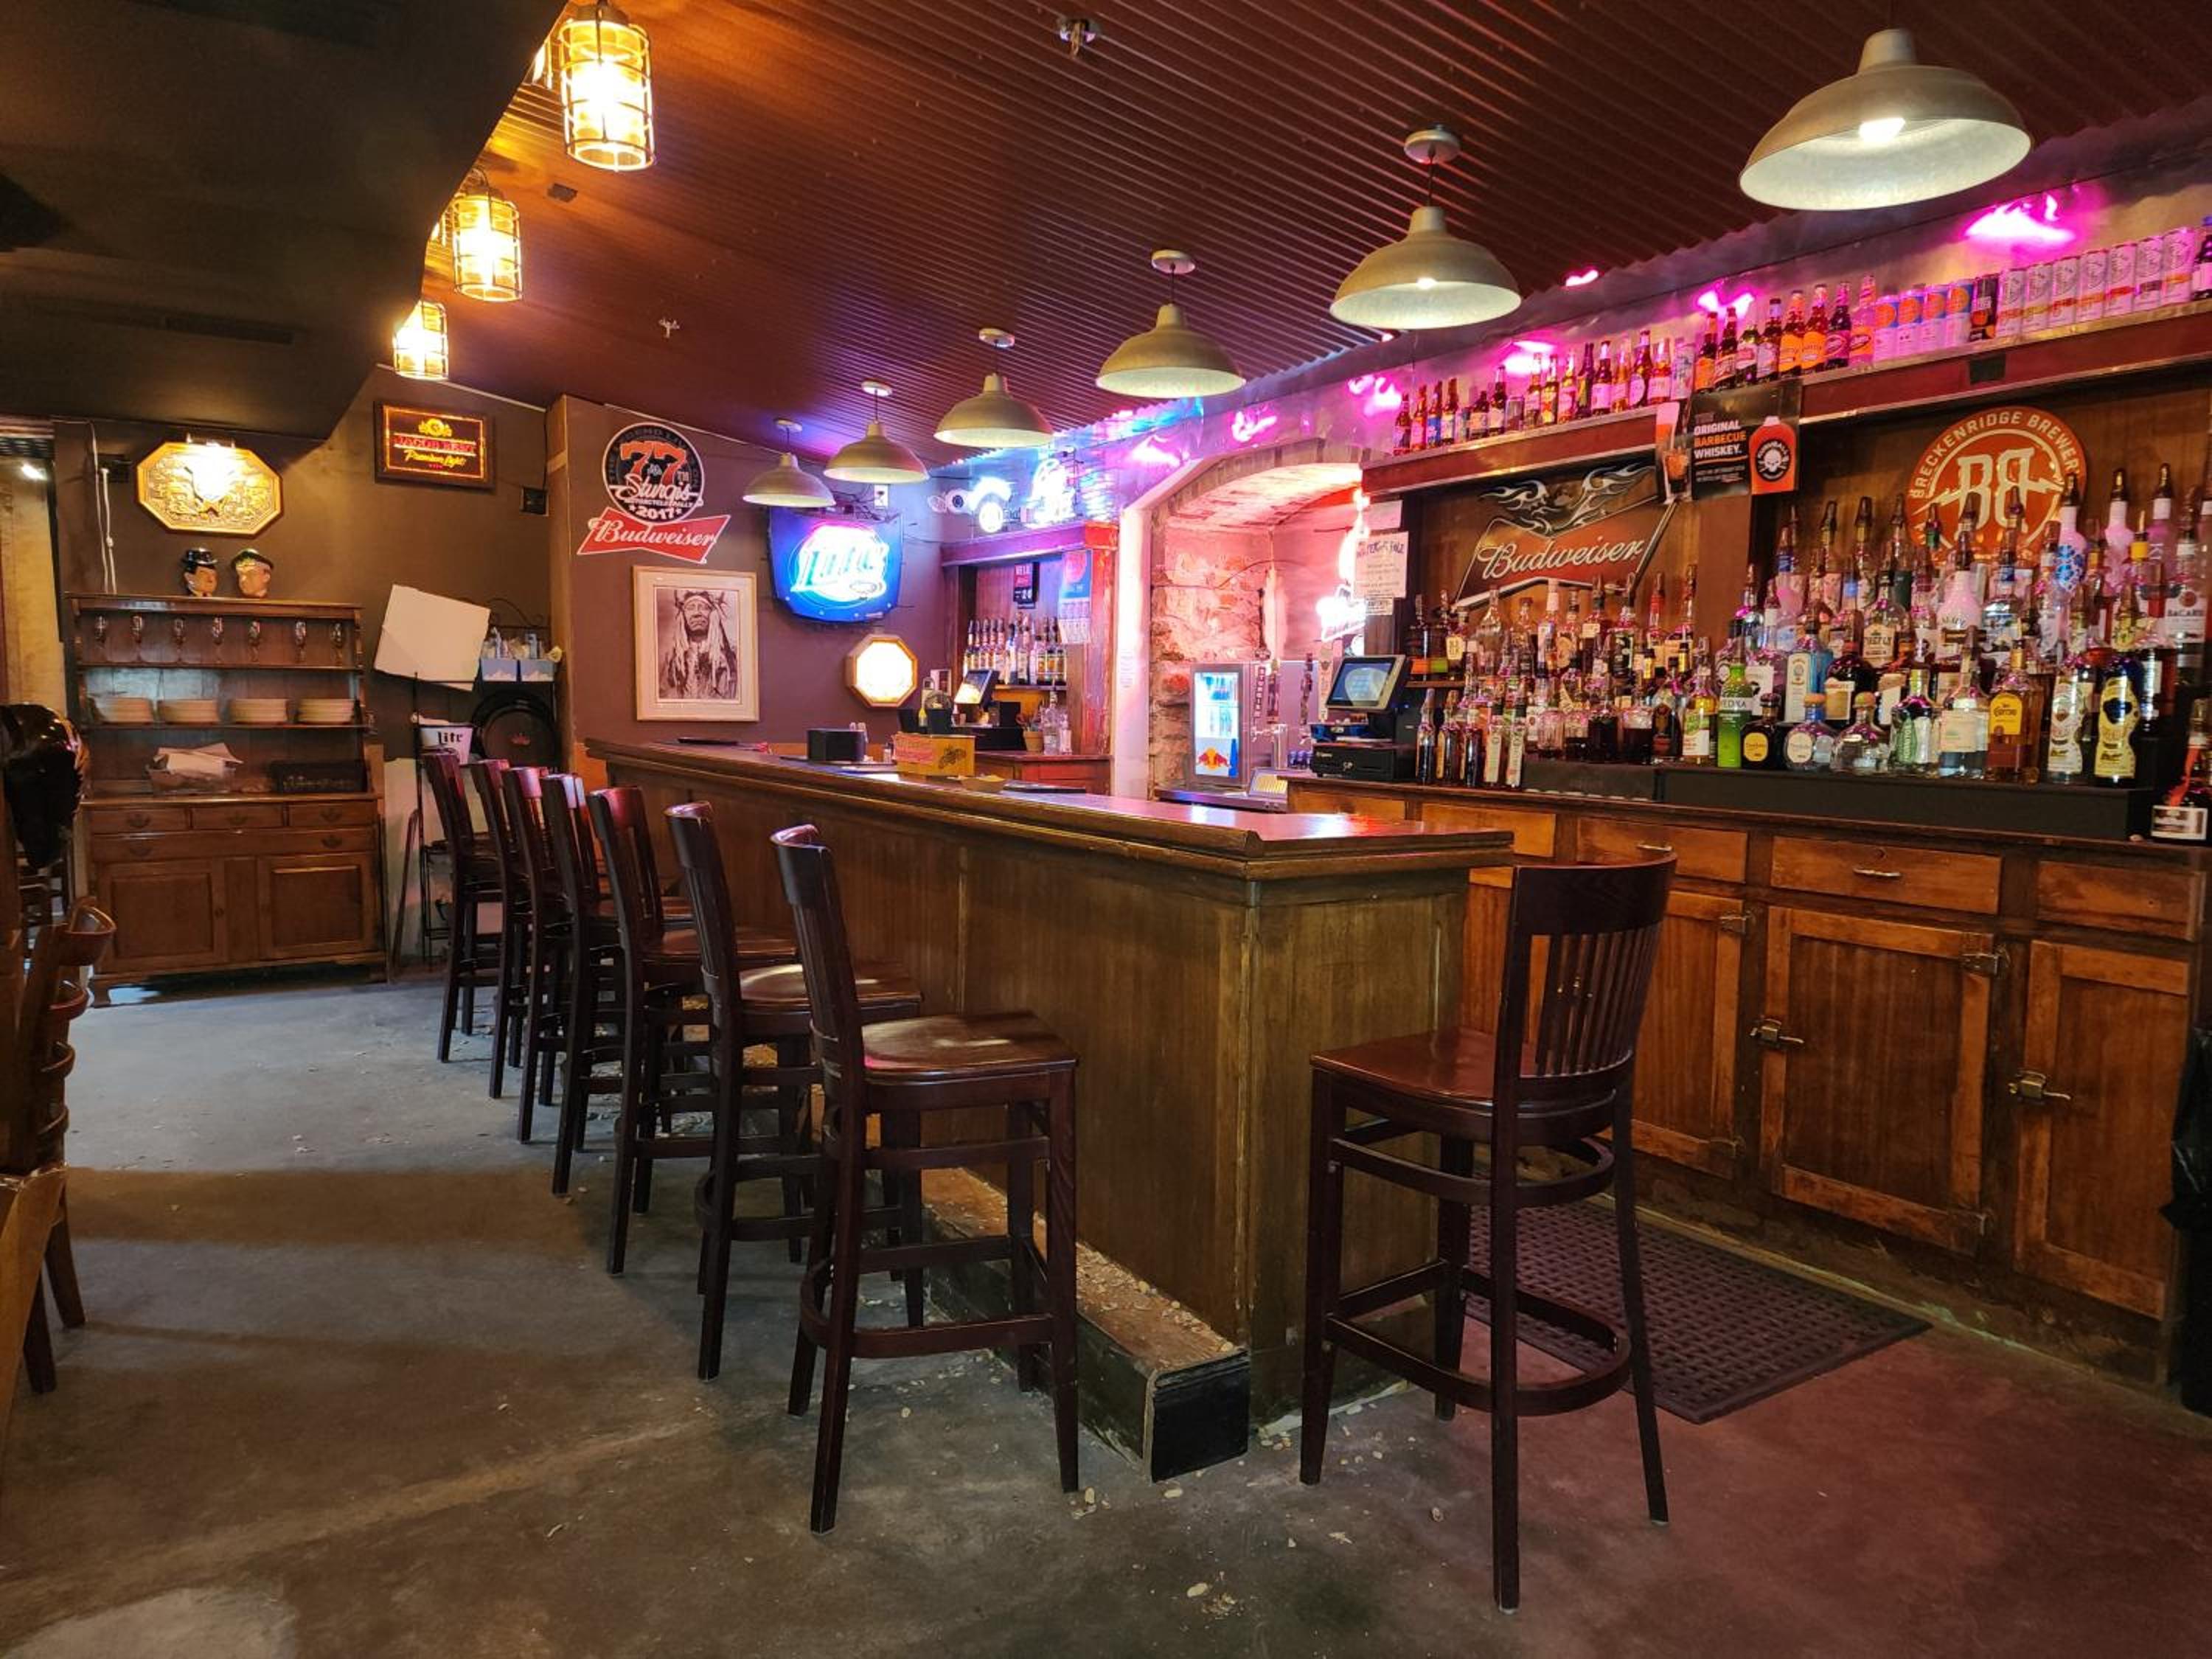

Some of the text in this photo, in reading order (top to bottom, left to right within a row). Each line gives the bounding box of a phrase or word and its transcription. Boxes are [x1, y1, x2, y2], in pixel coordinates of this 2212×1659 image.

[1694, 420, 1742, 436] ORIGINAL
[1694, 430, 1747, 448] BARBECUE
[620, 440, 686, 489] 77
[1694, 443, 1743, 459] WHISKEY.
[1910, 410, 2081, 499] BRECKENRIDGE BREWER
[615, 473, 694, 505] Sturgis
[634, 505, 675, 520] 2017
[588, 518, 717, 547] Budweiser
[1476, 535, 1645, 580] Budweiser
